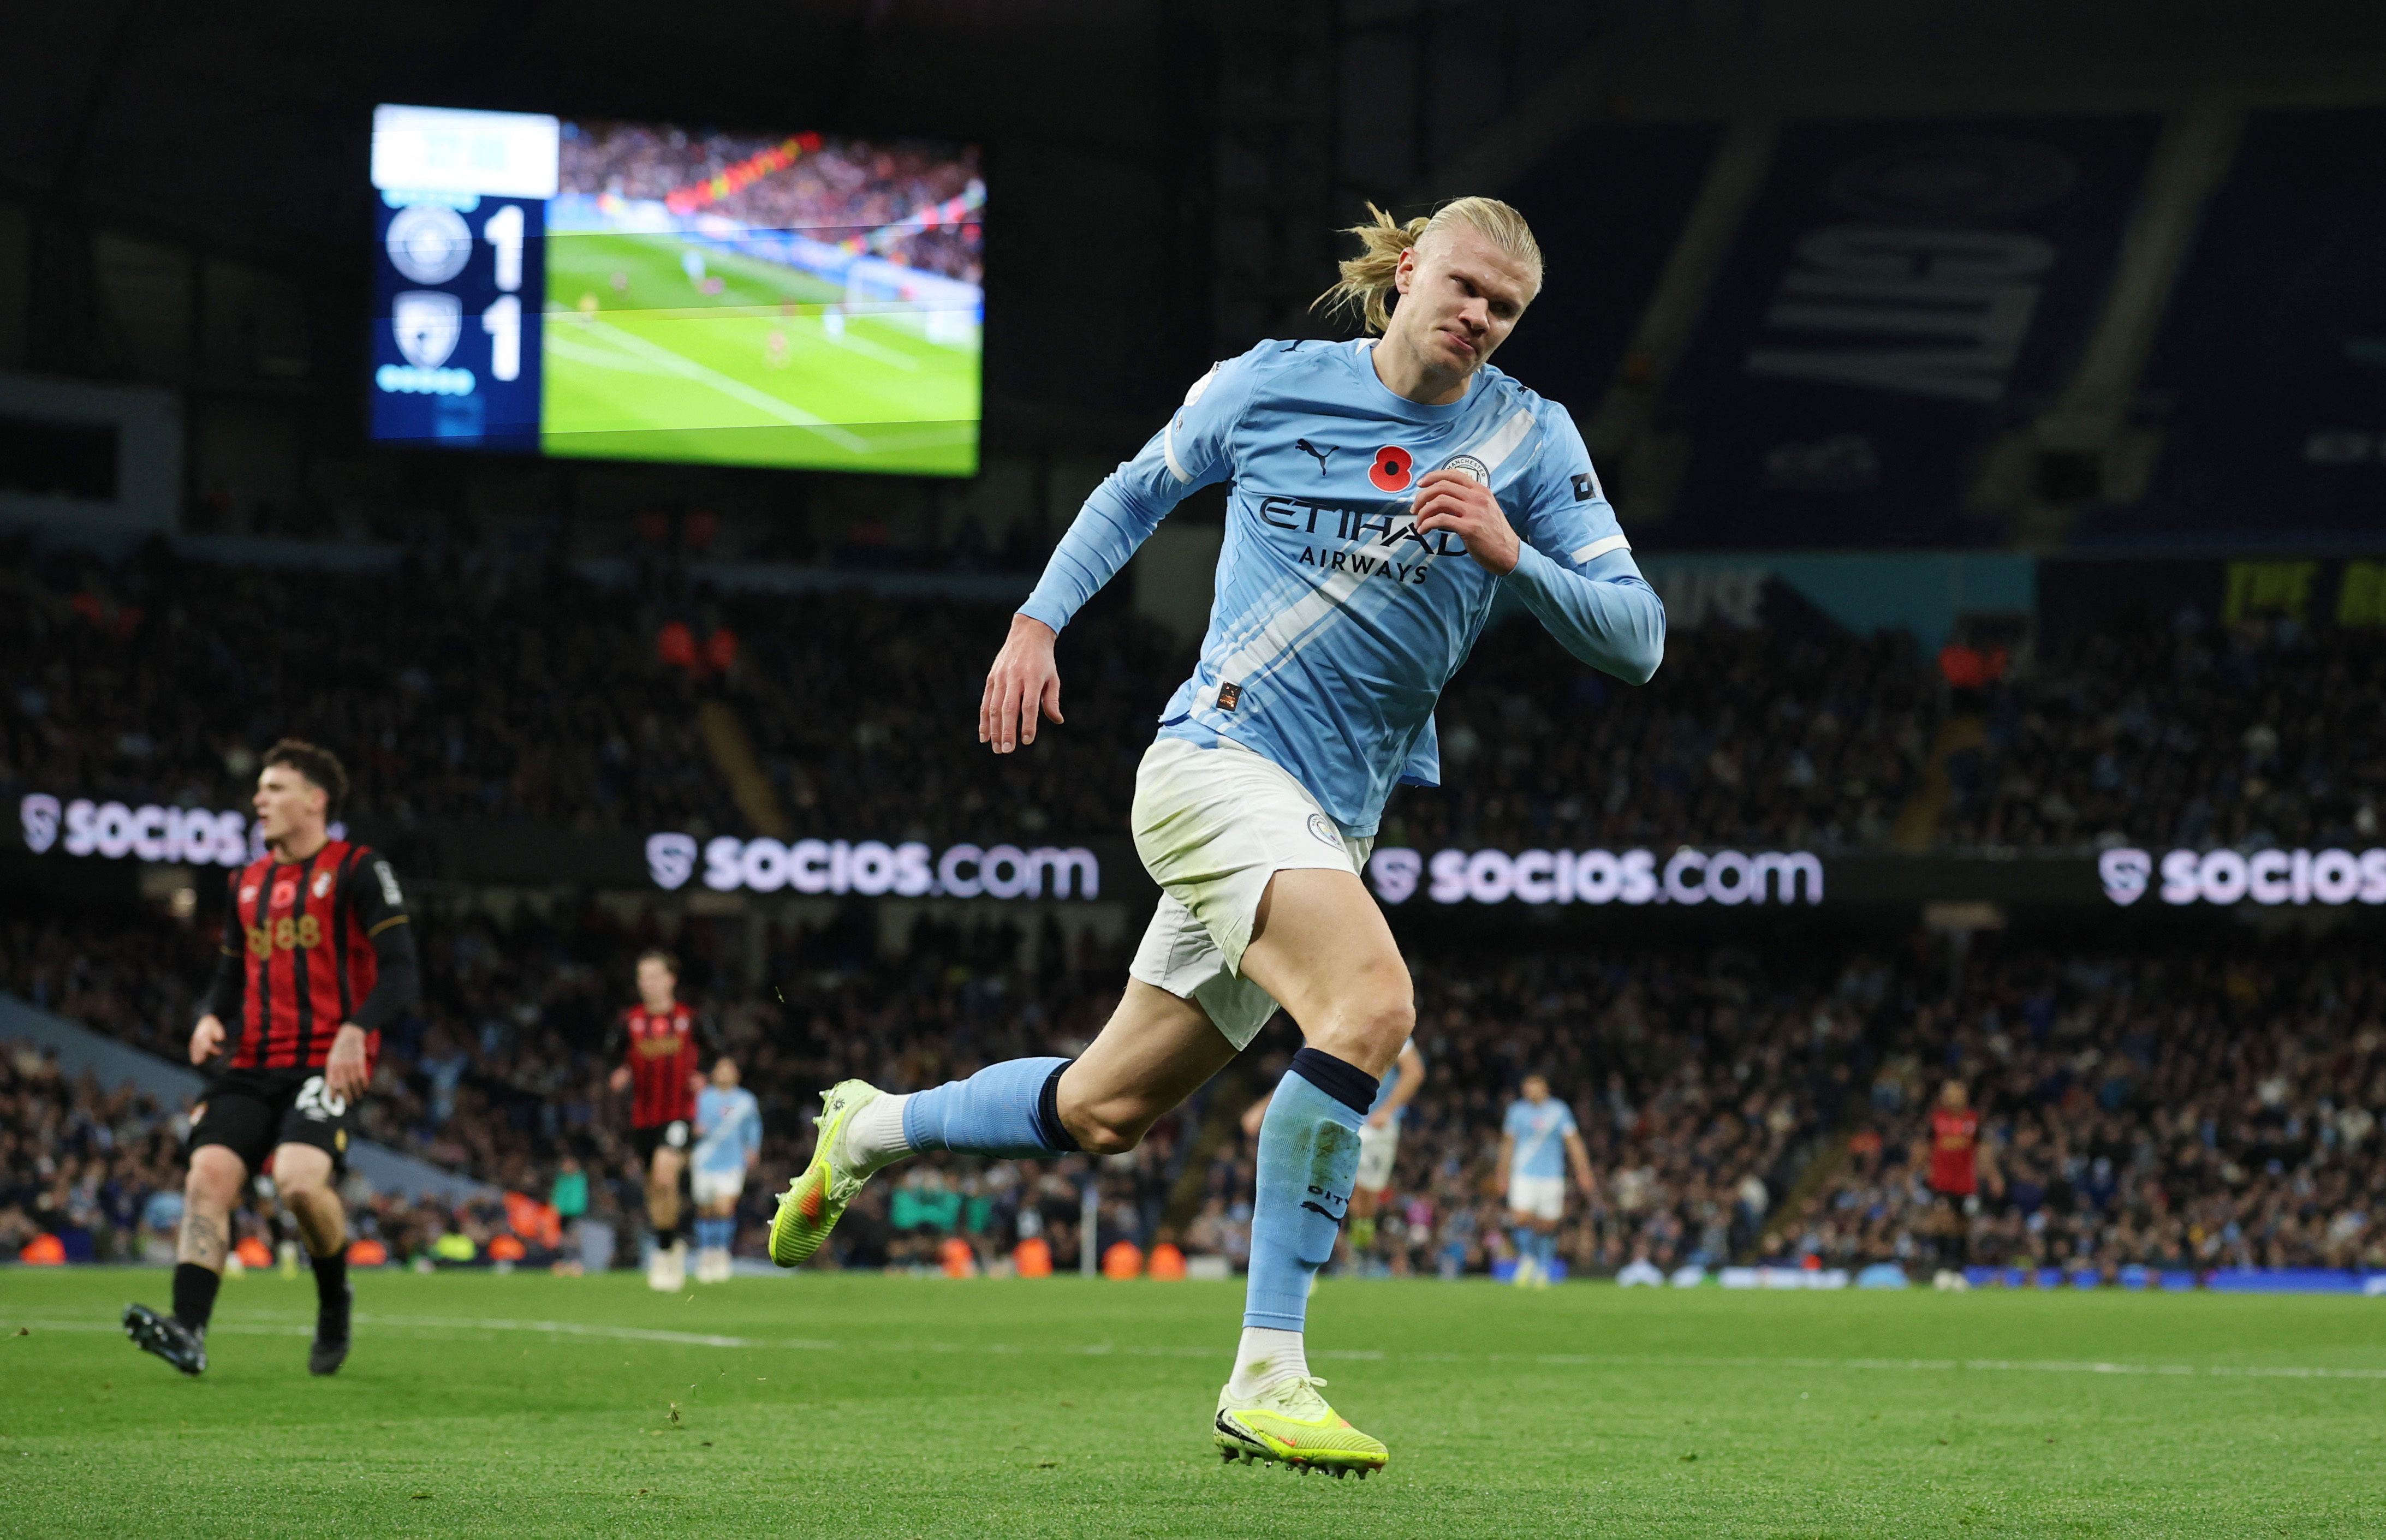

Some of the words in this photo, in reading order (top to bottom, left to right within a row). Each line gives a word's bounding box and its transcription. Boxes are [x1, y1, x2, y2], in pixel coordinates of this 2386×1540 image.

[484, 205, 525, 293] 1
[481, 294, 522, 381] 1
[1447, 458, 1486, 477] MANCHESTER
[1259, 497, 1468, 557] ETIHAD
[1299, 546, 1427, 584] AIRWAYS
[2159, 847, 2386, 906] SOCIOS
